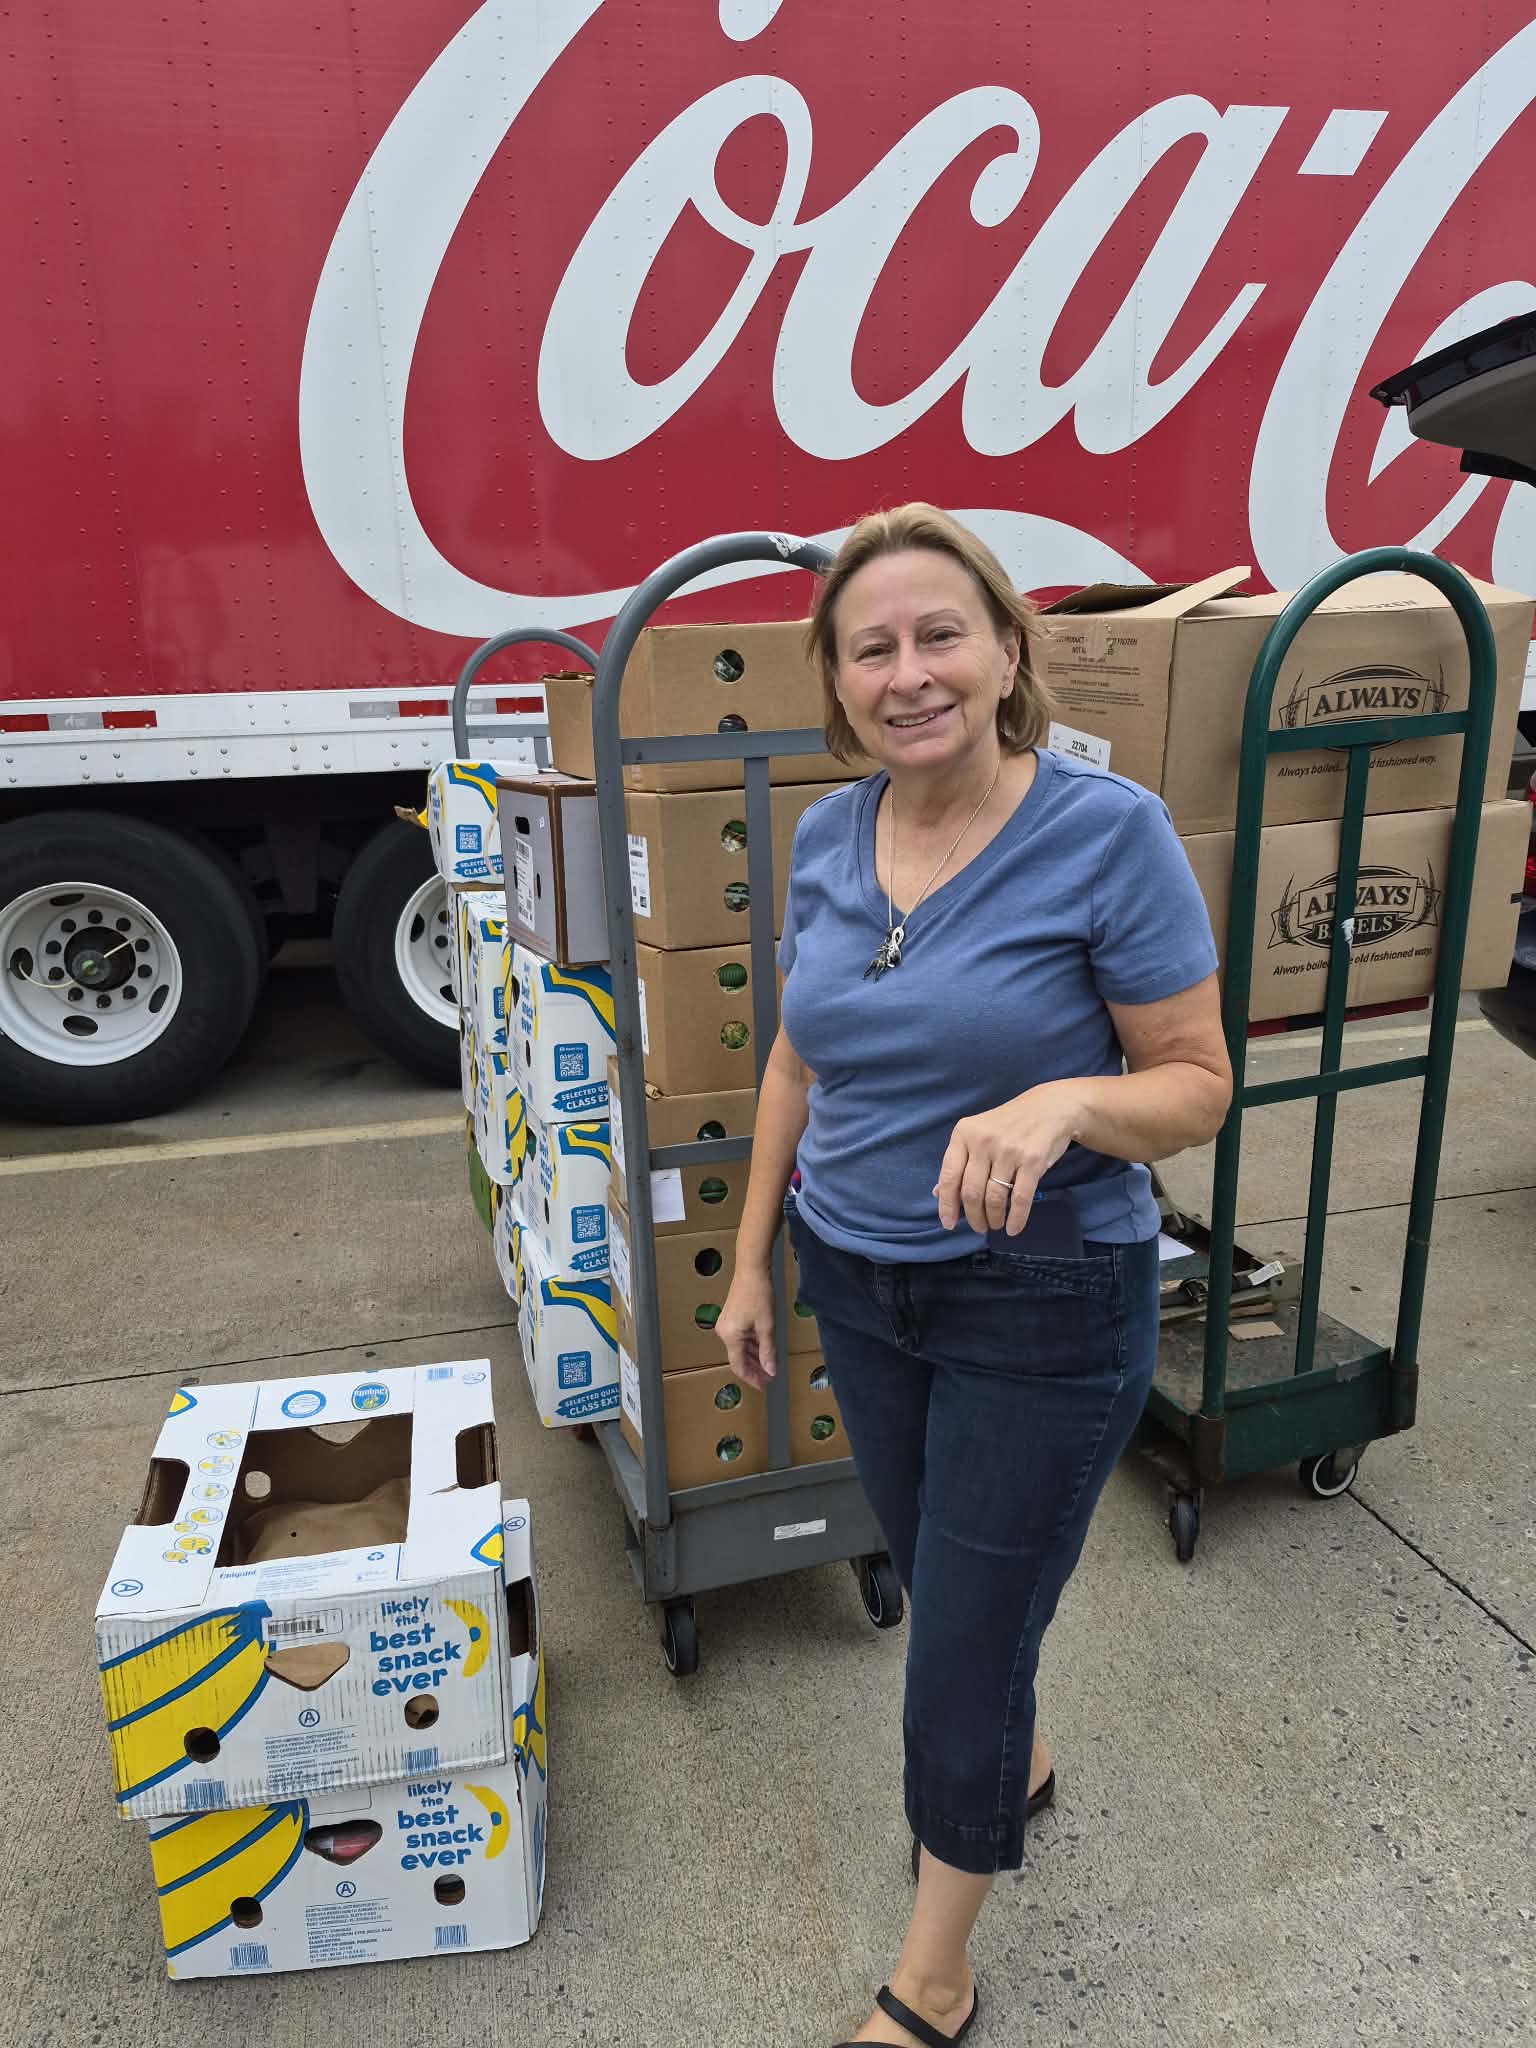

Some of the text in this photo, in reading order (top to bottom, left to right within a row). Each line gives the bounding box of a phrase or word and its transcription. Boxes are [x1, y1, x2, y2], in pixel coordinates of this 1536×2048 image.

[298, 0, 1536, 640] Coca-C
[1313, 686, 1421, 718] ALWAYS
[1278, 767, 1310, 778] Always
[1376, 753, 1418, 769] fashioned
[460, 859, 484, 868] SELECTE
[464, 866, 489, 876] CLASS
[1317, 914, 1393, 941] BELS
[1272, 962, 1305, 977] Always
[1354, 951, 1370, 964] old
[1370, 946, 1415, 962] fashioned
[561, 1086, 598, 1101] SELECTED
[566, 1096, 597, 1110] CLASS
[579, 1248, 609, 1261] SELECTE
[583, 1256, 610, 1270] CLAS
[565, 1391, 601, 1407] SELECTED
[569, 1394, 620, 1416] CLASS EXT
[381, 1596, 429, 1617] likely
[395, 1615, 420, 1628] the
[369, 1622, 436, 1653] best
[378, 1640, 461, 1673] snack
[372, 1667, 449, 1697] ever
[407, 1780, 452, 1798] likely
[421, 1796, 444, 1808] the
[397, 1804, 459, 1830] best
[406, 1823, 485, 1849] snack
[400, 1848, 472, 1871] ever
